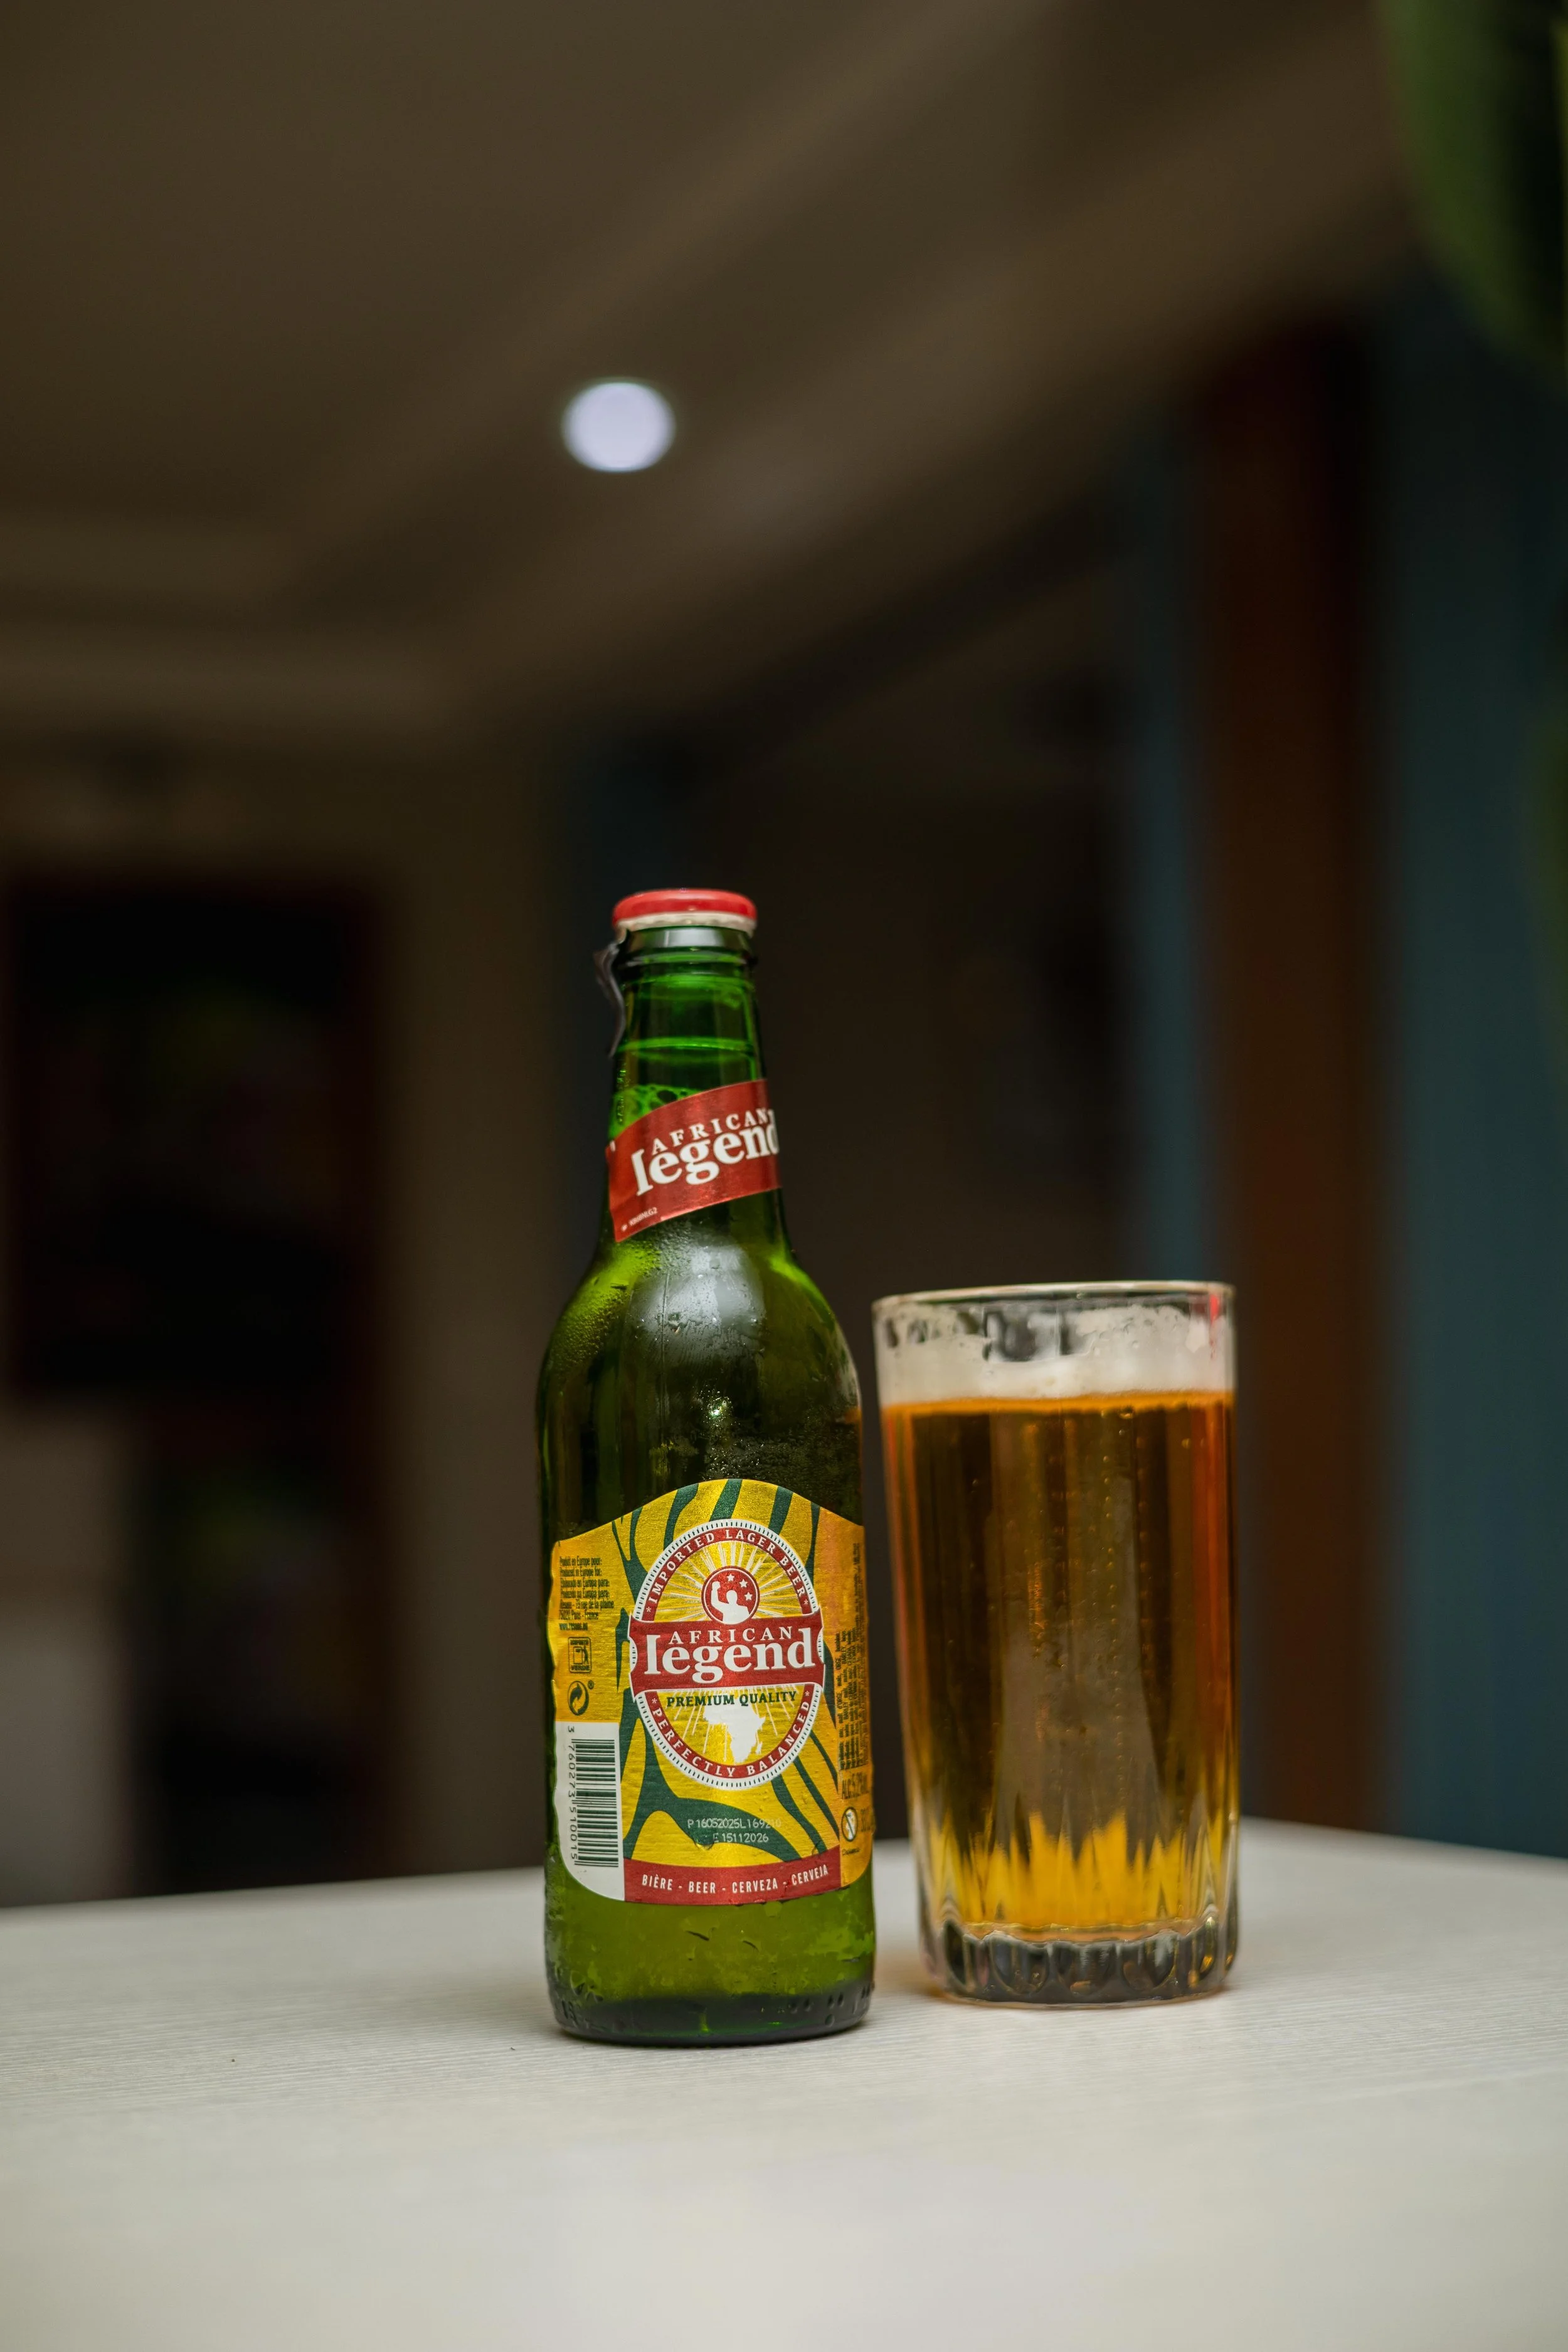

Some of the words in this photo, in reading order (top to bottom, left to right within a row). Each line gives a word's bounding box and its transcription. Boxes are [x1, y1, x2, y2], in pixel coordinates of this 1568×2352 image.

[631, 1108, 780, 1197] legend
[652, 1107, 769, 1155] AFRICAN
[648, 1532, 715, 1604] IMPORTED
[725, 1529, 776, 1554] LAGER
[780, 1555, 806, 1597] BEER
[644, 1627, 816, 1684] legend
[668, 1626, 793, 1645] AFRICAN
[666, 1695, 735, 1708] PREMIUM
[739, 1690, 797, 1707] QUALITY
[652, 1707, 737, 1777] PERFECTLY
[747, 1701, 810, 1776] BALANCED
[568, 1744, 576, 1798] 760273
[569, 1806, 578, 1860] 510015
[721, 1833, 769, 1843] 15112026
[642, 1873, 673, 1891] BIÈRE
[689, 1881, 716, 1894] BEER
[732, 1878, 778, 1894] CERVEZA
[792, 1864, 829, 1887] CERVEJA
